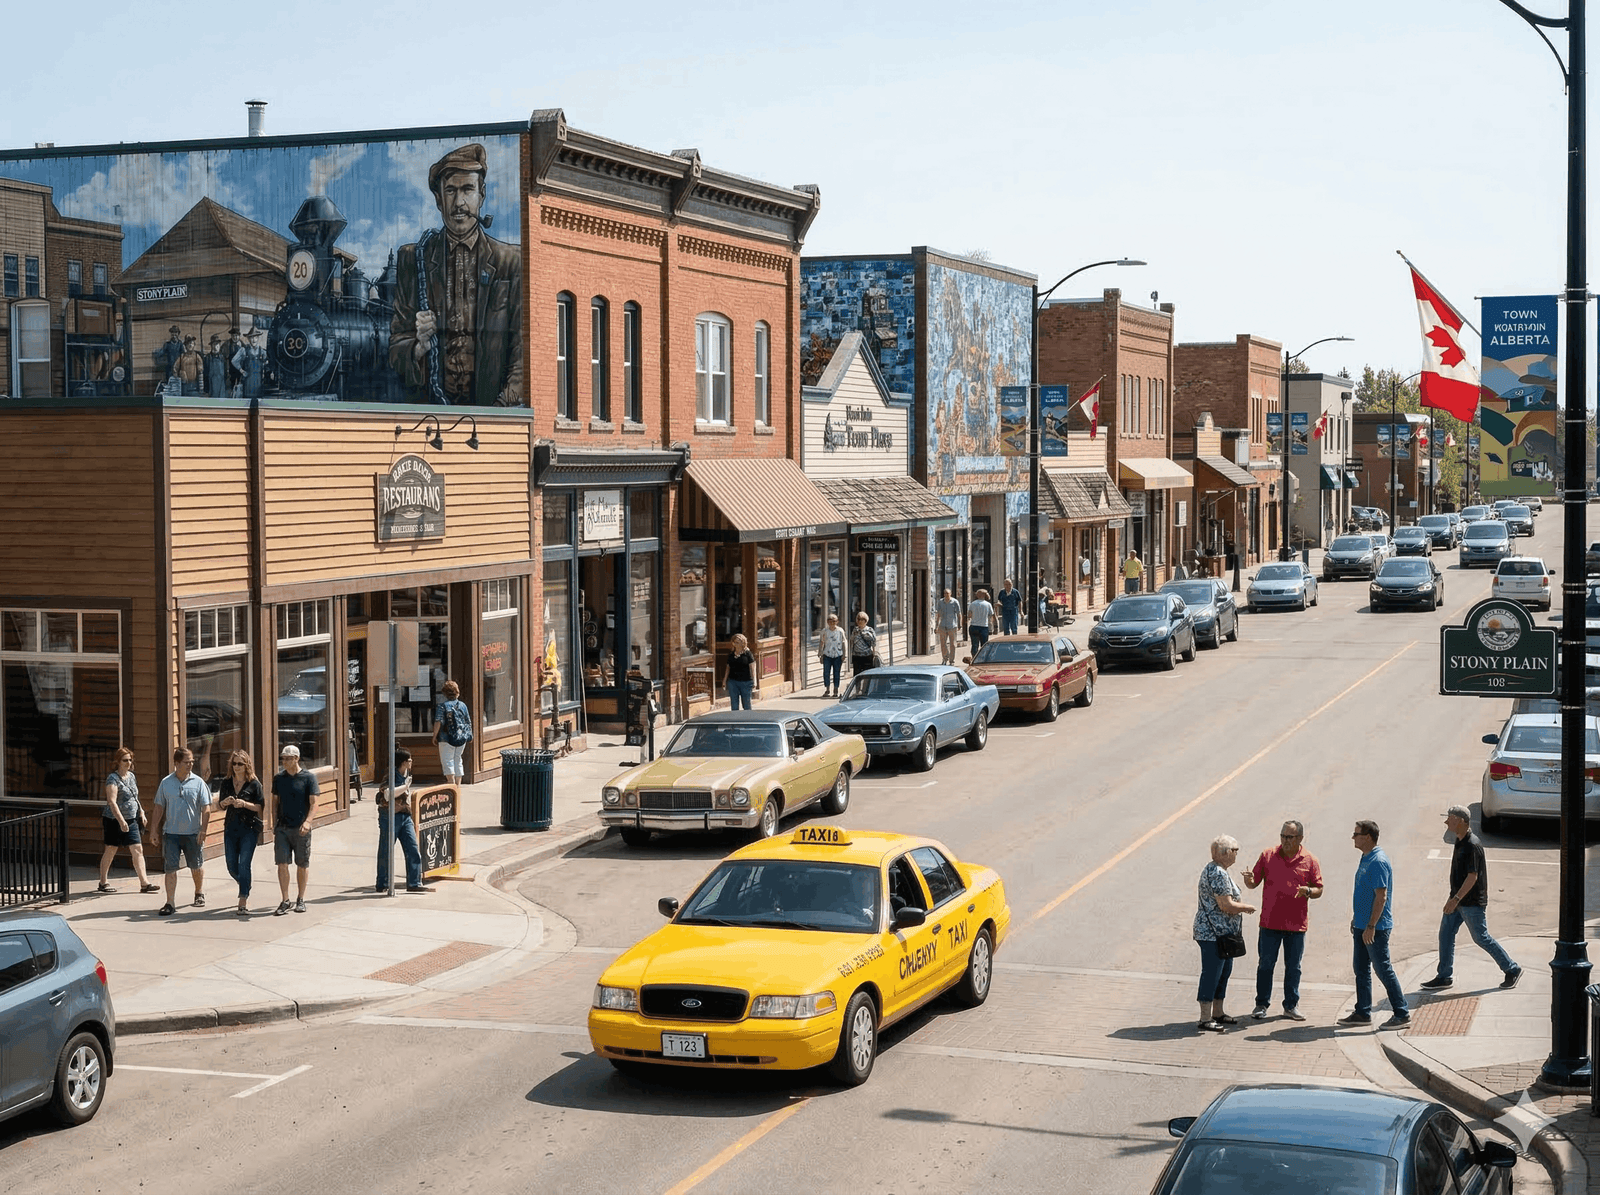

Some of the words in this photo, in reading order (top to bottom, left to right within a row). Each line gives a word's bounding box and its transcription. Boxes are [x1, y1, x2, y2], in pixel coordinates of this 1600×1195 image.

[294, 262, 307, 278] 20
[138, 288, 162, 299] STONY
[163, 287, 186, 297] PLAIN
[1503, 310, 1538, 319] TOWN
[1490, 335, 1550, 346] ALBERTA
[383, 486, 440, 514] RESTAURANS
[1450, 655, 1500, 669] STONY
[1503, 657, 1549, 670] PLAIN
[1488, 678, 1505, 687] 108
[947, 918, 968, 949] TAXI
[669, 1040, 674, 1051] T
[680, 1041, 697, 1052] 123
